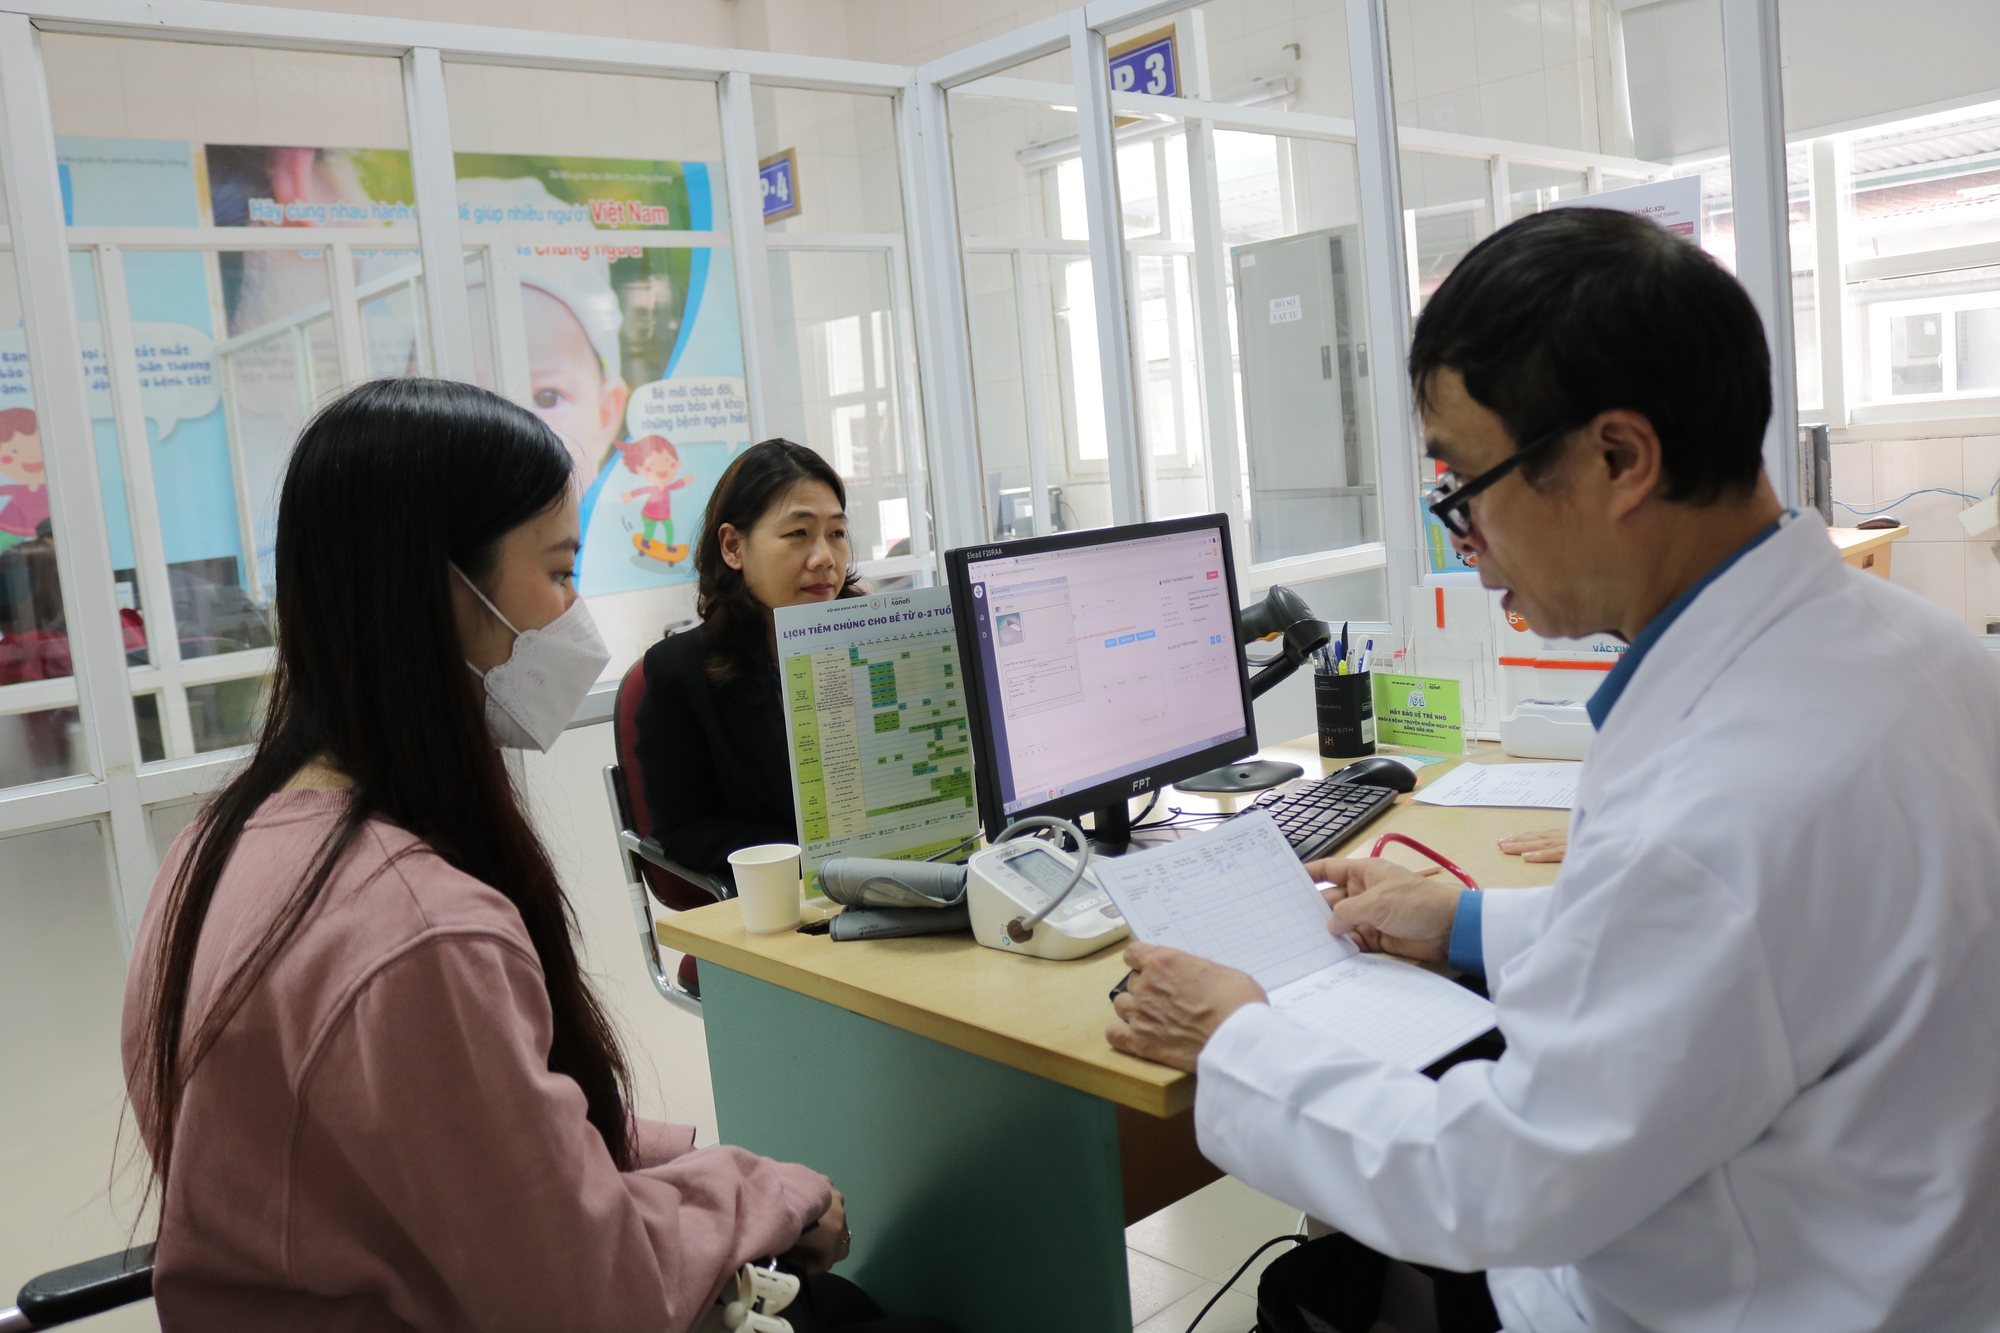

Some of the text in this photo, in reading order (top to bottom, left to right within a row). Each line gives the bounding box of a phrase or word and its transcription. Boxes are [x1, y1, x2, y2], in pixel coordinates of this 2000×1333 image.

[251, 200, 283, 223] Hãy
[287, 201, 327, 223] cùng
[330, 203, 367, 220] nhau
[372, 202, 408, 220] hành
[474, 204, 503, 225] giúp
[508, 203, 543, 221] nhiều
[548, 206, 589, 225] người
[590, 200, 623, 227] Việt
[628, 202, 668, 223] Nam
[1641, 205, 1665, 214] VẮC-XIN
[652, 387, 664, 399] Bé
[668, 386, 686, 398] mới
[690, 384, 714, 397] chào
[667, 402, 685, 413] sao
[687, 400, 707, 412] bảo
[710, 400, 721, 411] vệ
[641, 418, 673, 431] những
[676, 416, 701, 430] bệnh
[704, 414, 727, 428] nguy
[967, 548, 1002, 559] Elead F20RAA
[783, 604, 952, 640] LỊCH TIÊM CHỦNG CHO BÉ TỪ 0-2 TUỔ
[1592, 642, 1611, 652] VẮC
[1402, 709, 1413, 717] BẢO
[1423, 711, 1433, 720] TRẺ
[1421, 720, 1435, 728] NHIỄM
[1132, 777, 1151, 792] FPT
